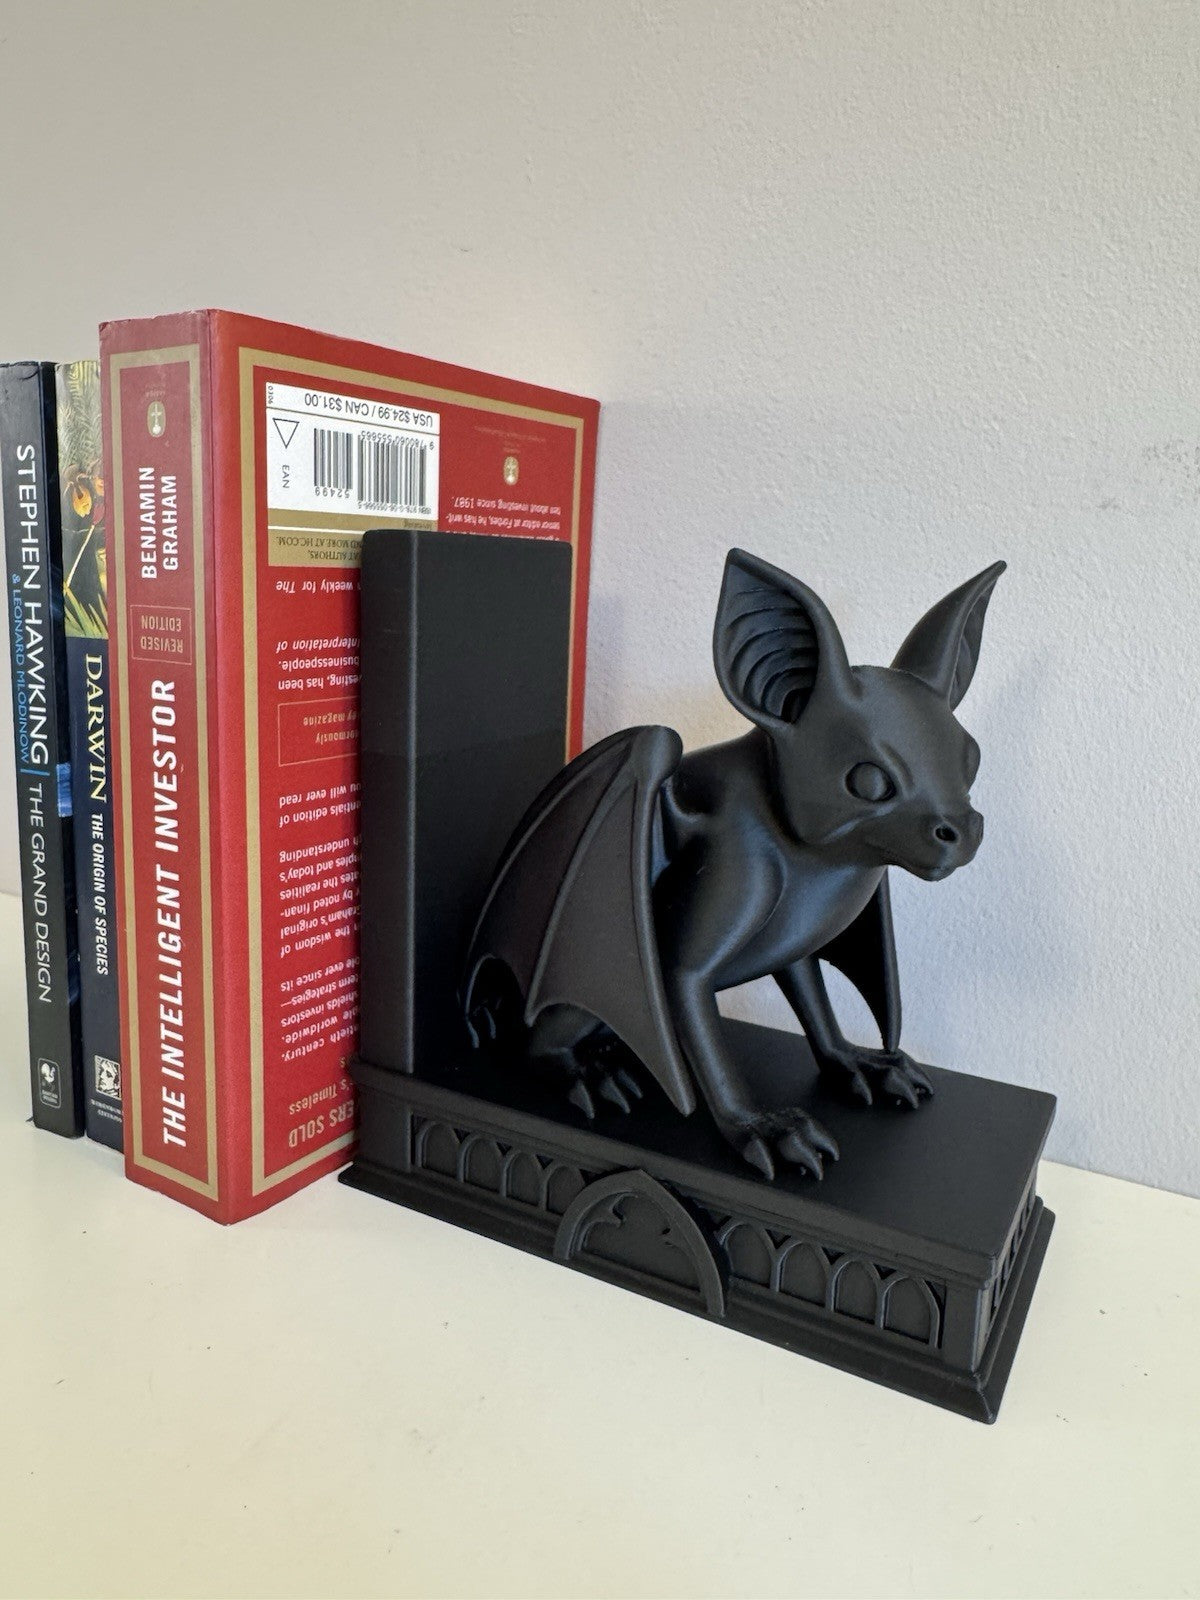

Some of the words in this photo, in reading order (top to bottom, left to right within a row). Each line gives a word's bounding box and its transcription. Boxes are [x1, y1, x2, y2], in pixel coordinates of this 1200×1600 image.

[304, 393, 343, 411] $31.00
[345, 400, 370, 417] CAN
[378, 405, 411, 424] $24.99
[412, 413, 433, 428] USA
[282, 465, 290, 488] EAN
[314, 486, 350, 498] 52499
[451, 497, 475, 509] 1987.
[16, 443, 41, 590] STEPHEN
[139, 467, 158, 579] BENJAMIN
[161, 476, 179, 571] GRAHAM
[315, 538, 326, 547] AT
[326, 539, 350, 549] MORE
[12, 573, 21, 584] &
[275, 580, 296, 594] The
[302, 580, 317, 594] for
[320, 579, 354, 593] weekly
[13, 589, 25, 666] LEONARD
[141, 615, 182, 632] EDITION
[140, 636, 184, 654] REVISED
[275, 640, 288, 654] of
[24, 601, 49, 765] HAWKING
[278, 678, 304, 691] been
[306, 677, 324, 690] has
[327, 674, 361, 688] esting,
[16, 670, 29, 764] MLODINOW
[303, 712, 346, 727] magazine
[86, 653, 107, 804] DARWIN
[315, 730, 358, 746] ormously
[150, 679, 179, 853] INVESTOR
[279, 793, 302, 809] read
[305, 789, 327, 802] ever
[330, 785, 347, 799] will
[30, 783, 44, 828] THE
[293, 806, 328, 823] edition
[92, 813, 104, 840] THE
[279, 814, 290, 828] of
[279, 838, 350, 863] understanding
[32, 833, 48, 917] GRAND
[93, 842, 106, 892] ORIGIN
[279, 864, 314, 883] today's
[316, 859, 334, 875] and
[279, 881, 321, 901] realities
[322, 876, 338, 889] the
[313, 894, 340, 912] noted
[342, 889, 353, 901] by
[94, 895, 106, 915] OF
[280, 902, 311, 918] finan-
[280, 918, 319, 939] original
[335, 925, 351, 938] the
[95, 916, 109, 976] SPECIES
[295, 931, 332, 951] wisdom
[280, 944, 291, 959] of
[35, 921, 52, 1003] DESIGN
[324, 961, 344, 977] ever
[156, 863, 185, 1081] INTELLIGENT
[295, 969, 323, 987] since
[280, 980, 294, 992] its
[280, 1003, 325, 1028] investors
[281, 1016, 338, 1044] worldwide.
[281, 1037, 325, 1062] century.
[289, 1083, 338, 1115] Timeless
[162, 1086, 187, 1147] THE
[329, 1100, 355, 1128] ERS
[288, 1115, 325, 1148] SOLD
